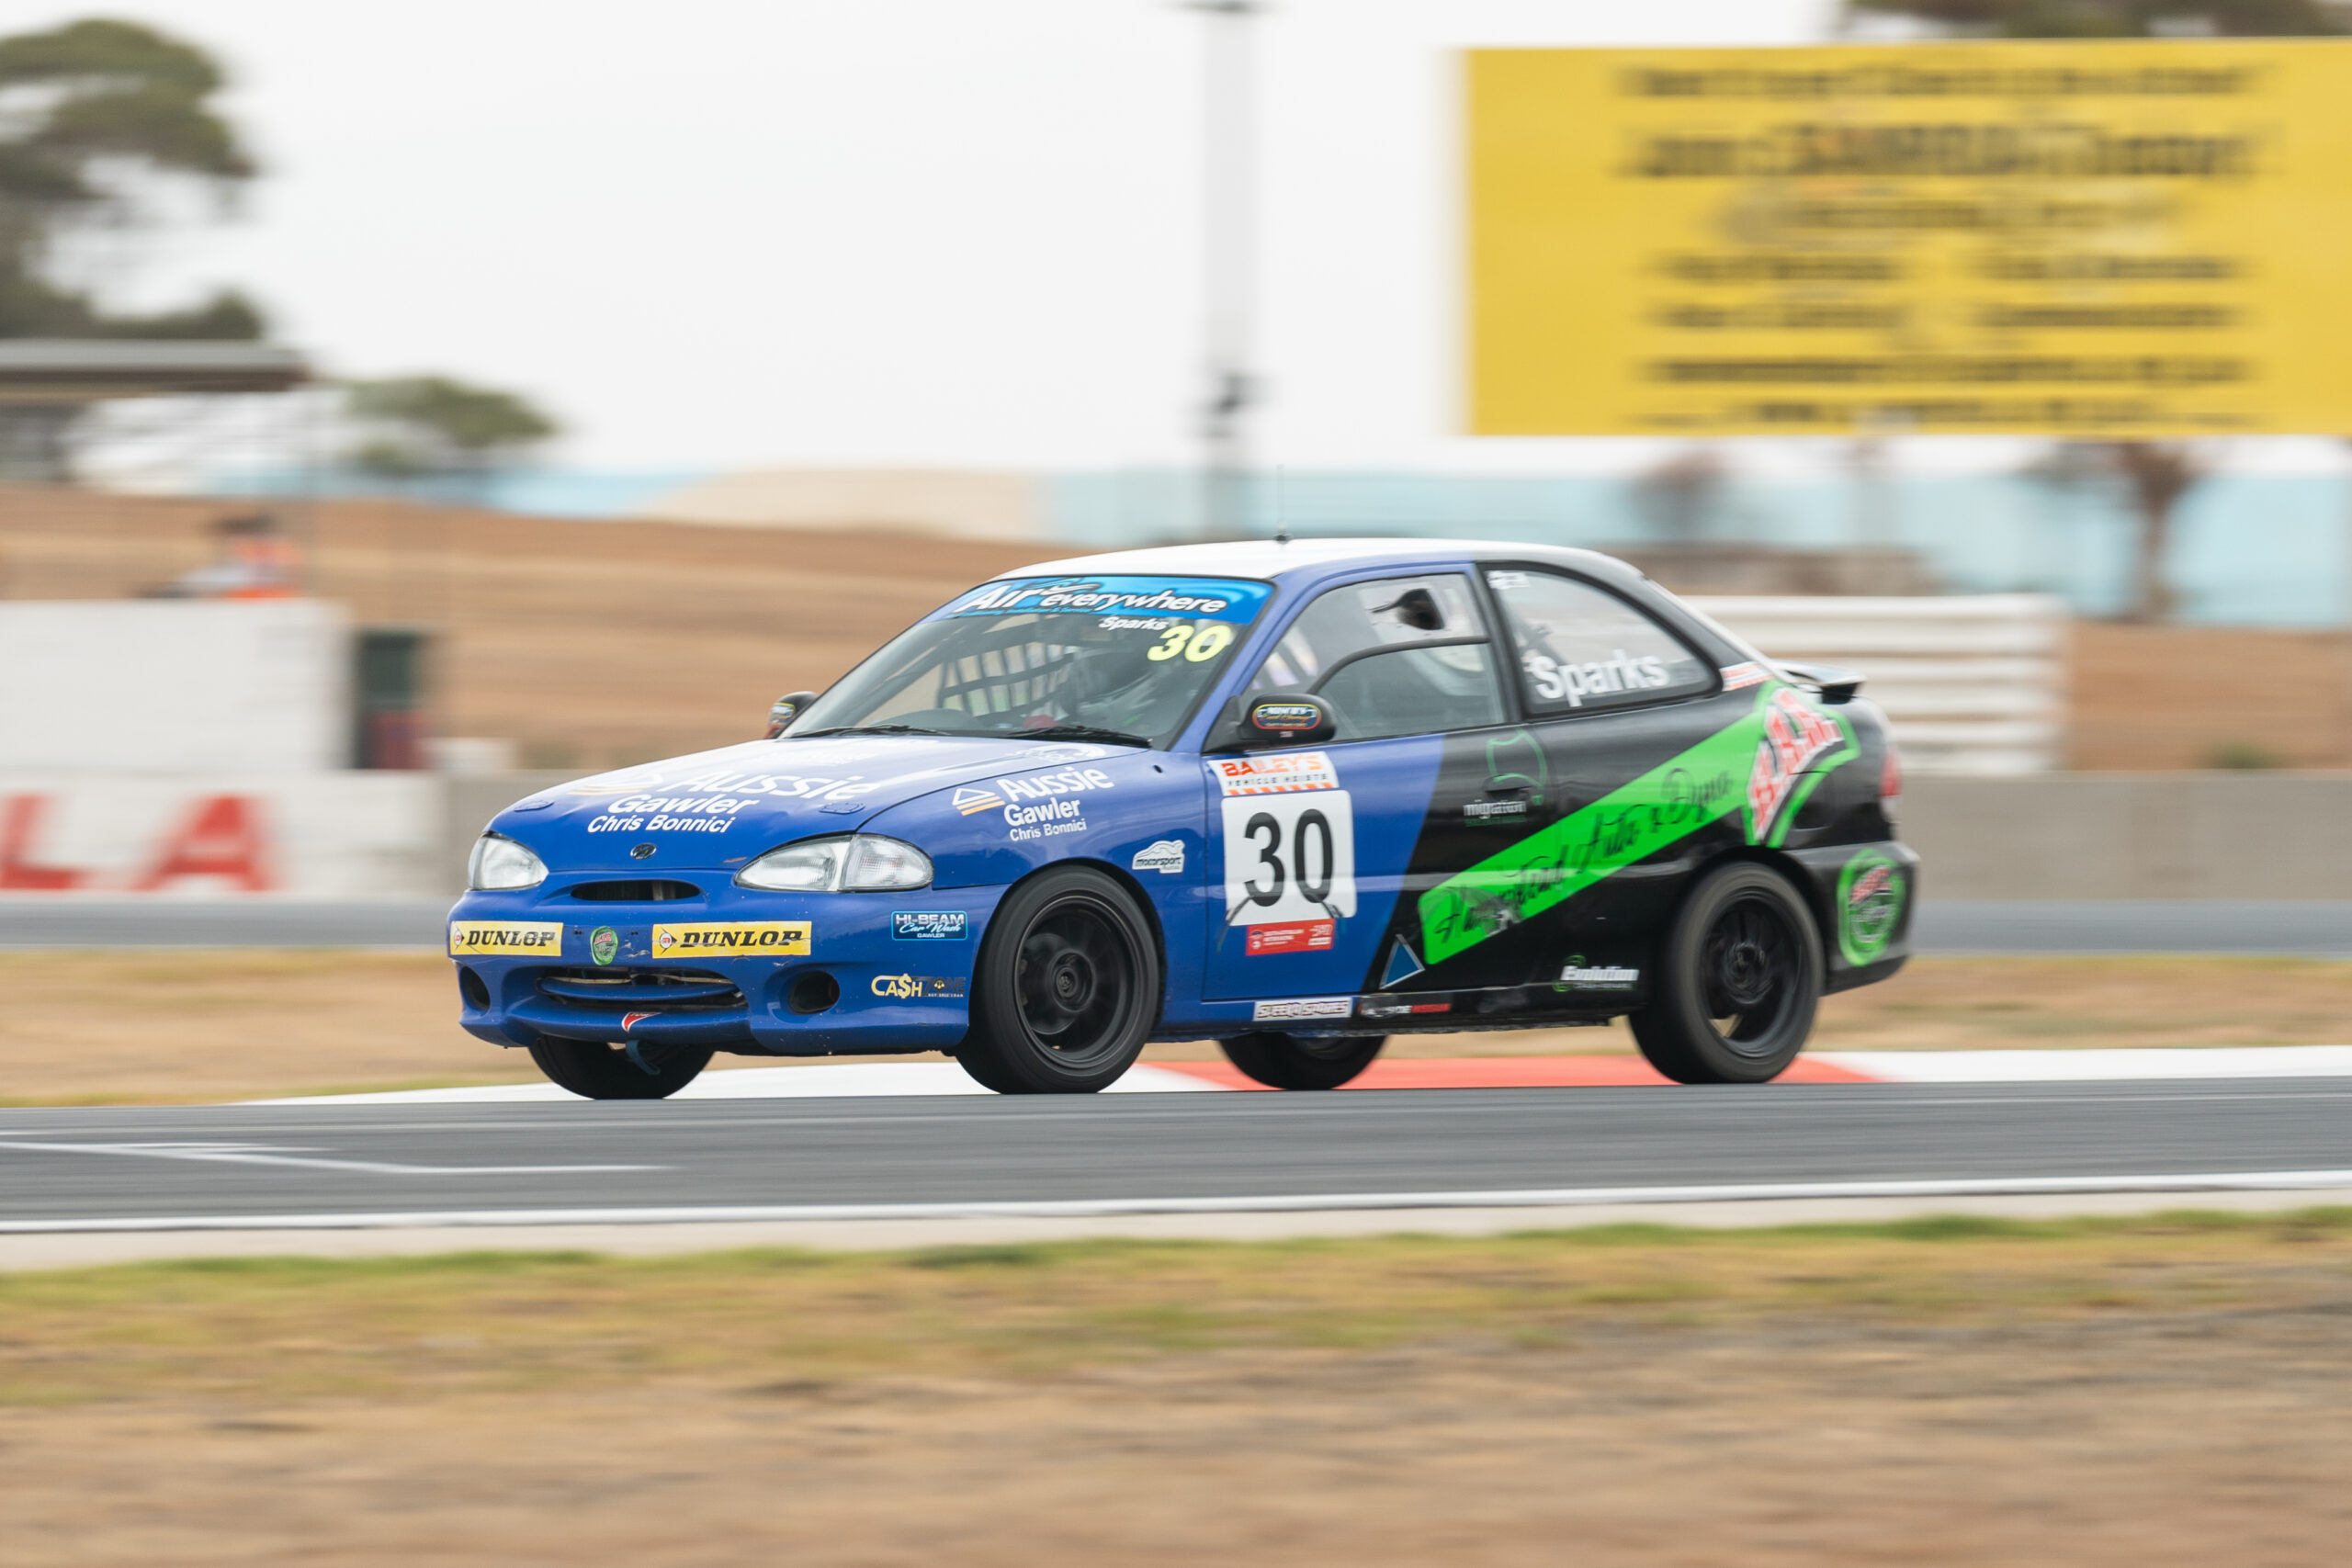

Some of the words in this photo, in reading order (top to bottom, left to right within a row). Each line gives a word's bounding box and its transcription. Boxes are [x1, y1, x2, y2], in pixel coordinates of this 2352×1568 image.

[952, 585, 1045, 614] Air
[1040, 590, 1227, 613] everywhere
[1099, 615, 1169, 631] Sparks
[1147, 625, 1232, 662] 30
[1531, 649, 1668, 707] Sparks
[656, 770, 883, 800] Aussie
[996, 767, 1114, 801] Aussie
[607, 794, 760, 814] Gawler
[1003, 797, 1080, 827] Gawler
[588, 814, 642, 832] Chris
[645, 814, 736, 832] Bonnici
[1010, 826, 1042, 841] Chris
[1044, 818, 1088, 835] Bonnici
[1244, 808, 1334, 908] 30
[896, 914, 965, 924] HI-BEAM
[899, 922, 925, 933] Car
[466, 930, 556, 947] DUNLOP
[680, 930, 803, 948] DUNLOP
